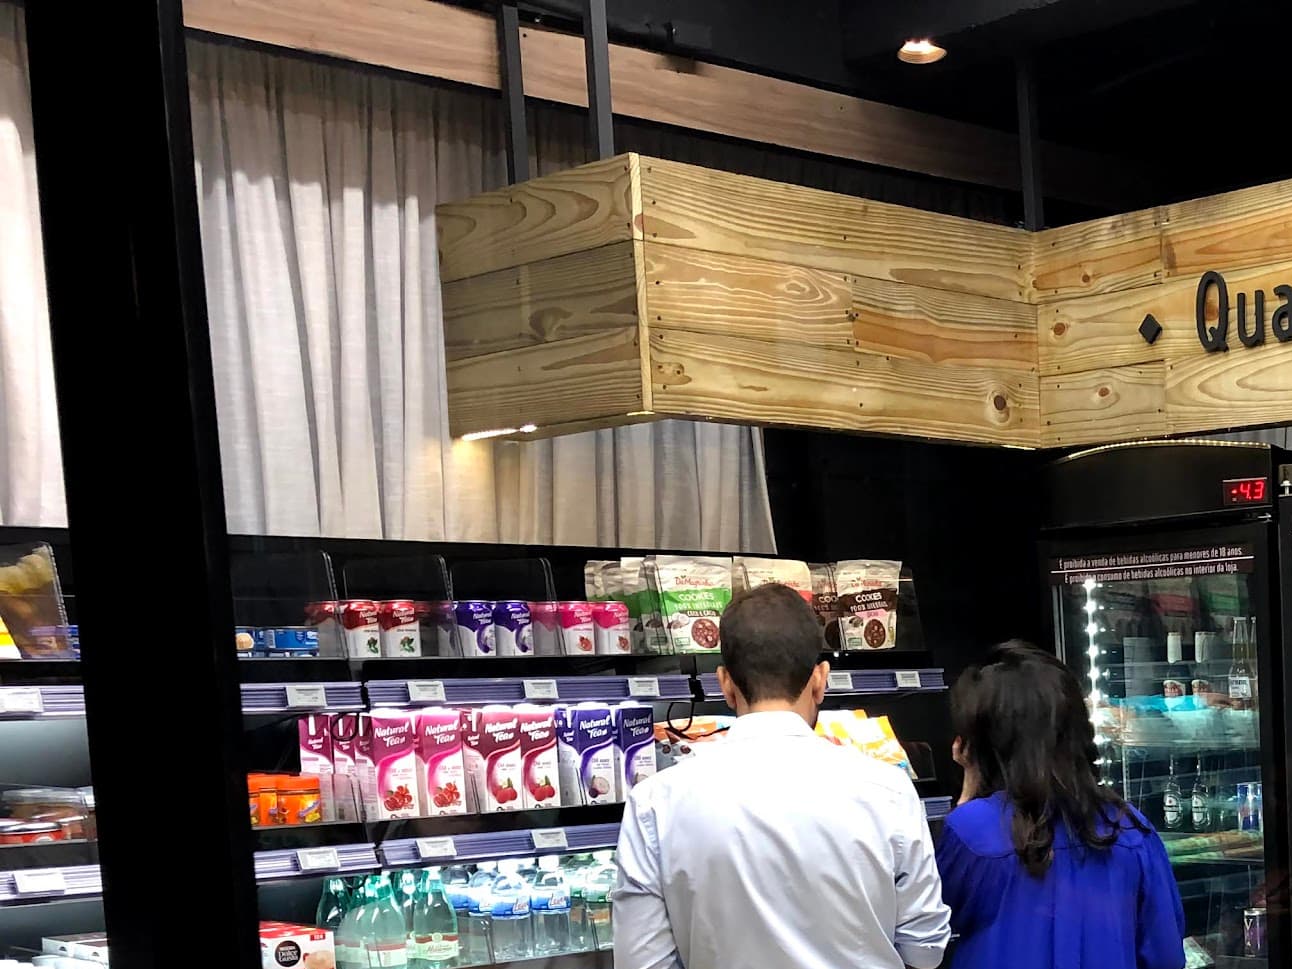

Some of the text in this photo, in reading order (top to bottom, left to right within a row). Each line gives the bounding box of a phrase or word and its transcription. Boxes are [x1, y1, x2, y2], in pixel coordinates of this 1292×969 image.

[425, 719, 460, 736] Natural
[485, 717, 518, 734] Natural
[520, 716, 553, 733] Natural
[579, 714, 612, 731] Natural
